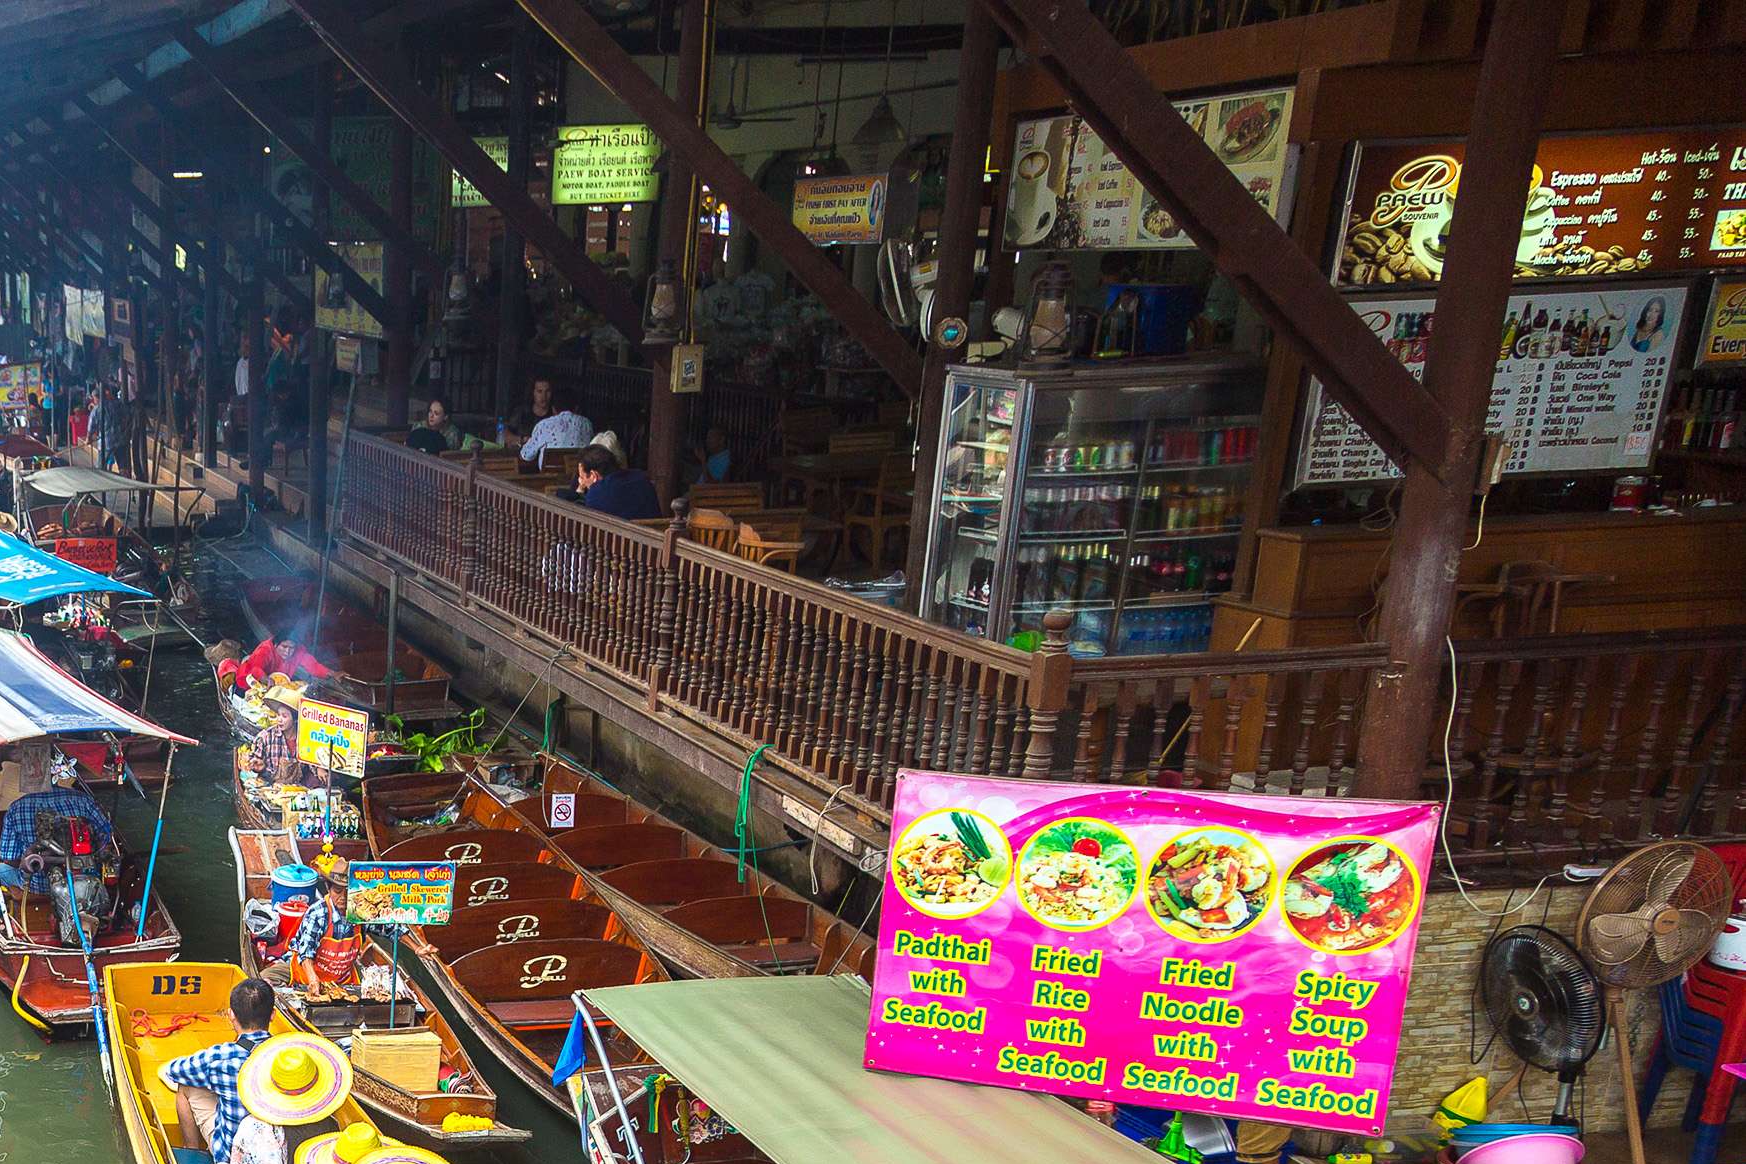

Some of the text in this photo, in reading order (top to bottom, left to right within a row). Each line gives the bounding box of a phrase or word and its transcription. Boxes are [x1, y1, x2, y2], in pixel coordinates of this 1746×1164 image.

[558, 167, 655, 179] PAEW BOAT SERVIC
[1550, 171, 1597, 189] Espresso
[606, 180, 630, 188] PADDLE
[1546, 194, 1570, 206] Coffee
[1403, 212, 1439, 222] SOUVENIR
[1608, 360, 1633, 368] Pepsi
[1576, 372, 1598, 380] Coca
[1601, 371, 1622, 380] Cola
[1572, 382, 1609, 392] Bireley's
[1576, 394, 1594, 402] One
[1597, 393, 1617, 403] Way
[1566, 405, 1593, 413] Mineral
[1595, 405, 1615, 413] water
[1345, 438, 1372, 447] Chang
[1591, 436, 1619, 445] Coconut
[1341, 449, 1369, 457] Chang
[1342, 460, 1367, 468] Singha
[1342, 470, 1368, 479] Singha
[302, 708, 364, 732] Grilled Bananas
[378, 884, 448, 893] Grilled Skewered
[401, 895, 446, 904] Milk Pork
[896, 934, 990, 965] Padthai
[1034, 948, 1099, 976] Fried
[911, 971, 964, 995] with
[1163, 961, 1233, 988] Fried
[1036, 983, 1088, 1010] Rice
[1298, 973, 1377, 1006] Spicy
[884, 1002, 984, 1032] Seafood
[1143, 994, 1242, 1026] Noodle
[1029, 1018, 1084, 1044] with
[1292, 1011, 1364, 1043] Soup
[1156, 1033, 1216, 1060] with
[1000, 1050, 1104, 1081] Seafood
[1292, 1050, 1354, 1075] with
[1126, 1065, 1237, 1098] Seafood
[1259, 1082, 1376, 1117] Seafood
